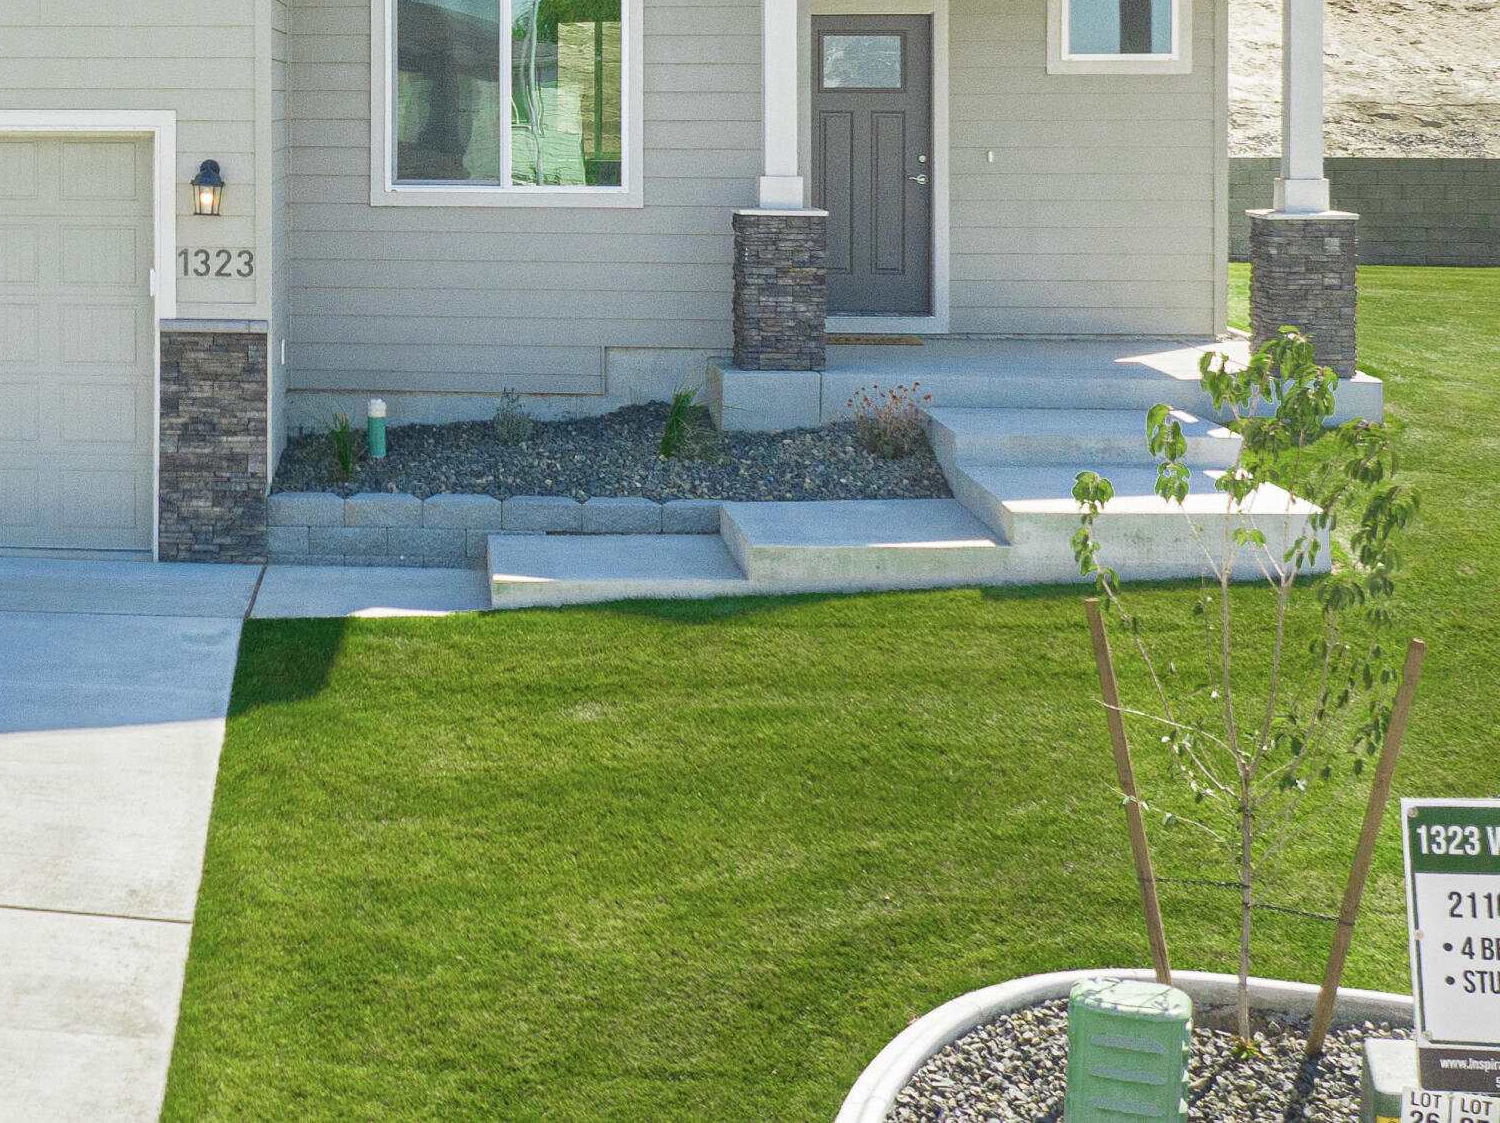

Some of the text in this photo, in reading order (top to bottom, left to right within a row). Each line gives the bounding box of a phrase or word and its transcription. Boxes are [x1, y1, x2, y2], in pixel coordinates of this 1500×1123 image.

[177, 248, 254, 278] 1323
[1416, 824, 1481, 856] 1323
[1447, 891, 1500, 919] 211
[1461, 936, 1475, 960] 4
[1439, 1057, 1500, 1073] www.Inspir
[1411, 1091, 1442, 1109] LOT
[1461, 1098, 1493, 1116] LOT
